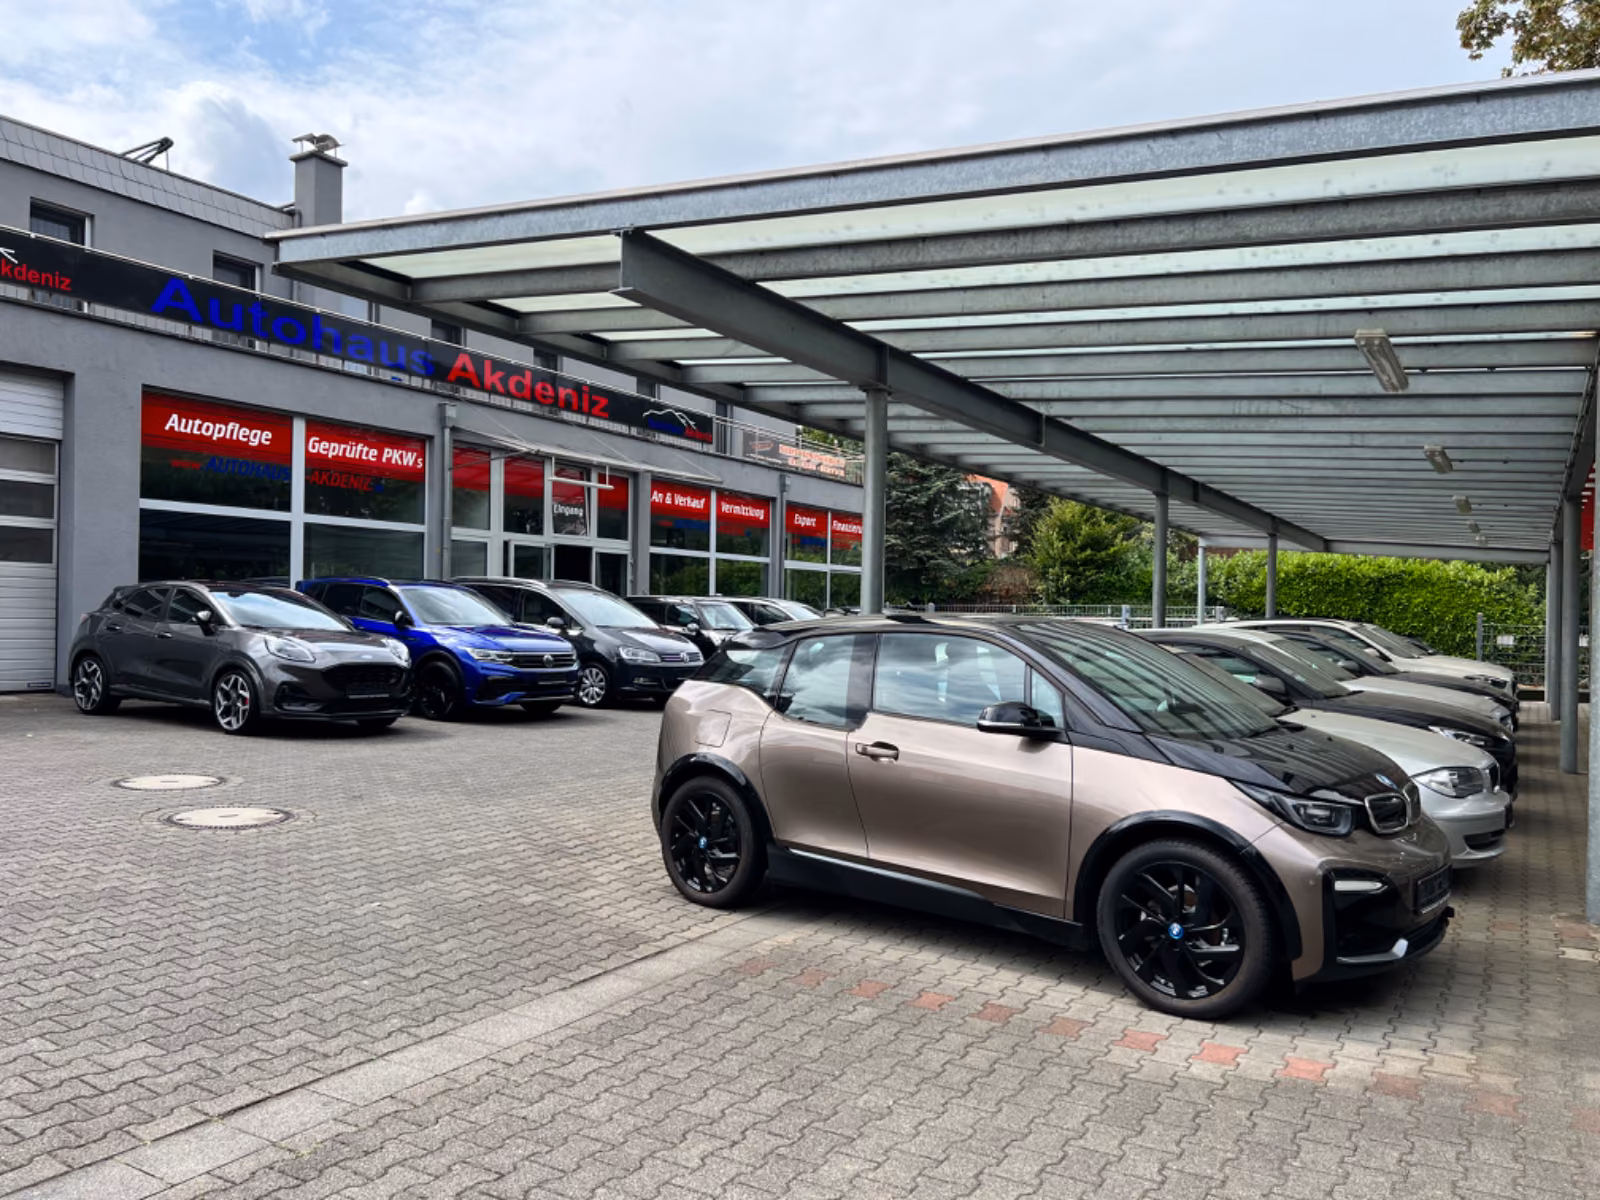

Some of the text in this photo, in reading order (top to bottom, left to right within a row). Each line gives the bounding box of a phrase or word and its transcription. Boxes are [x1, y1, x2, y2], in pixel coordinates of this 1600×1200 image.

[0, 257, 72, 291] kdeniz
[151, 277, 610, 419] Autohaus Akdeniz
[164, 413, 273, 446] Autopflege
[308, 436, 378, 462] Geprüfte
[553, 504, 583, 517] Eingang
[651, 490, 706, 509] An & Verkauf
[721, 501, 765, 520] Vermittlung
[794, 513, 817, 527] Export
